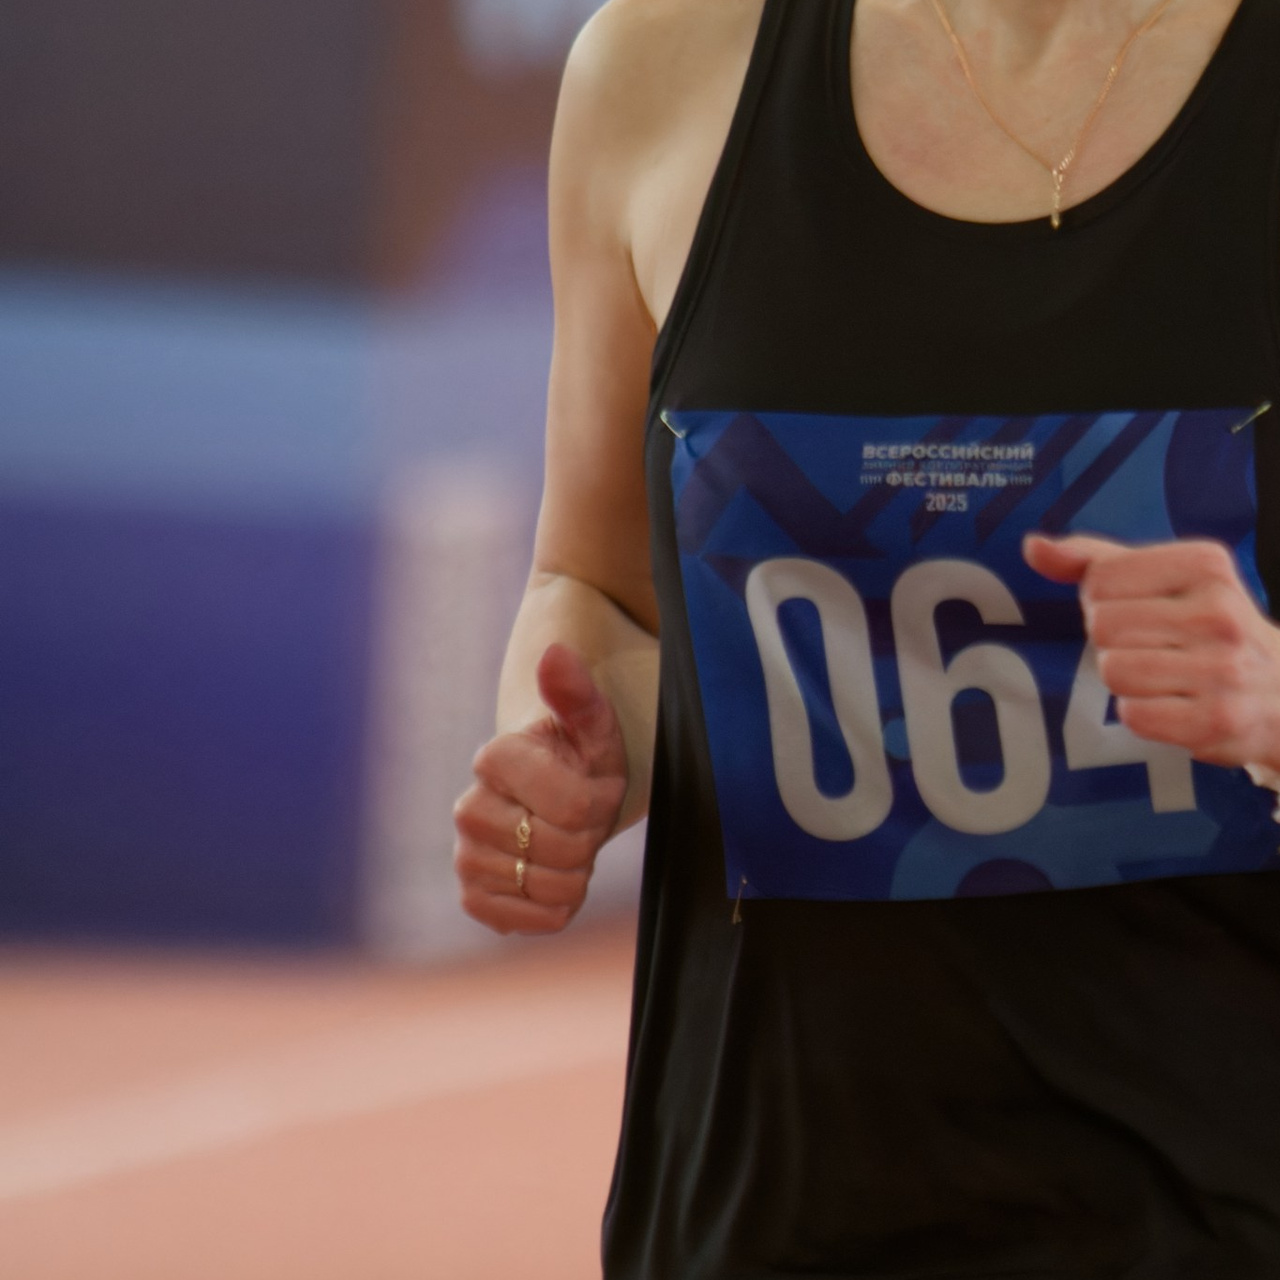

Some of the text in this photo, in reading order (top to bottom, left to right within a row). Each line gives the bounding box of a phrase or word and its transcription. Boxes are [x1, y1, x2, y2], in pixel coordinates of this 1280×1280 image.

[862, 443, 1033, 459] ВСЕРОССИЙСКИЙ
[886, 472, 1007, 487] ФЕСТИВАЛЬ
[926, 494, 968, 512] 2025
